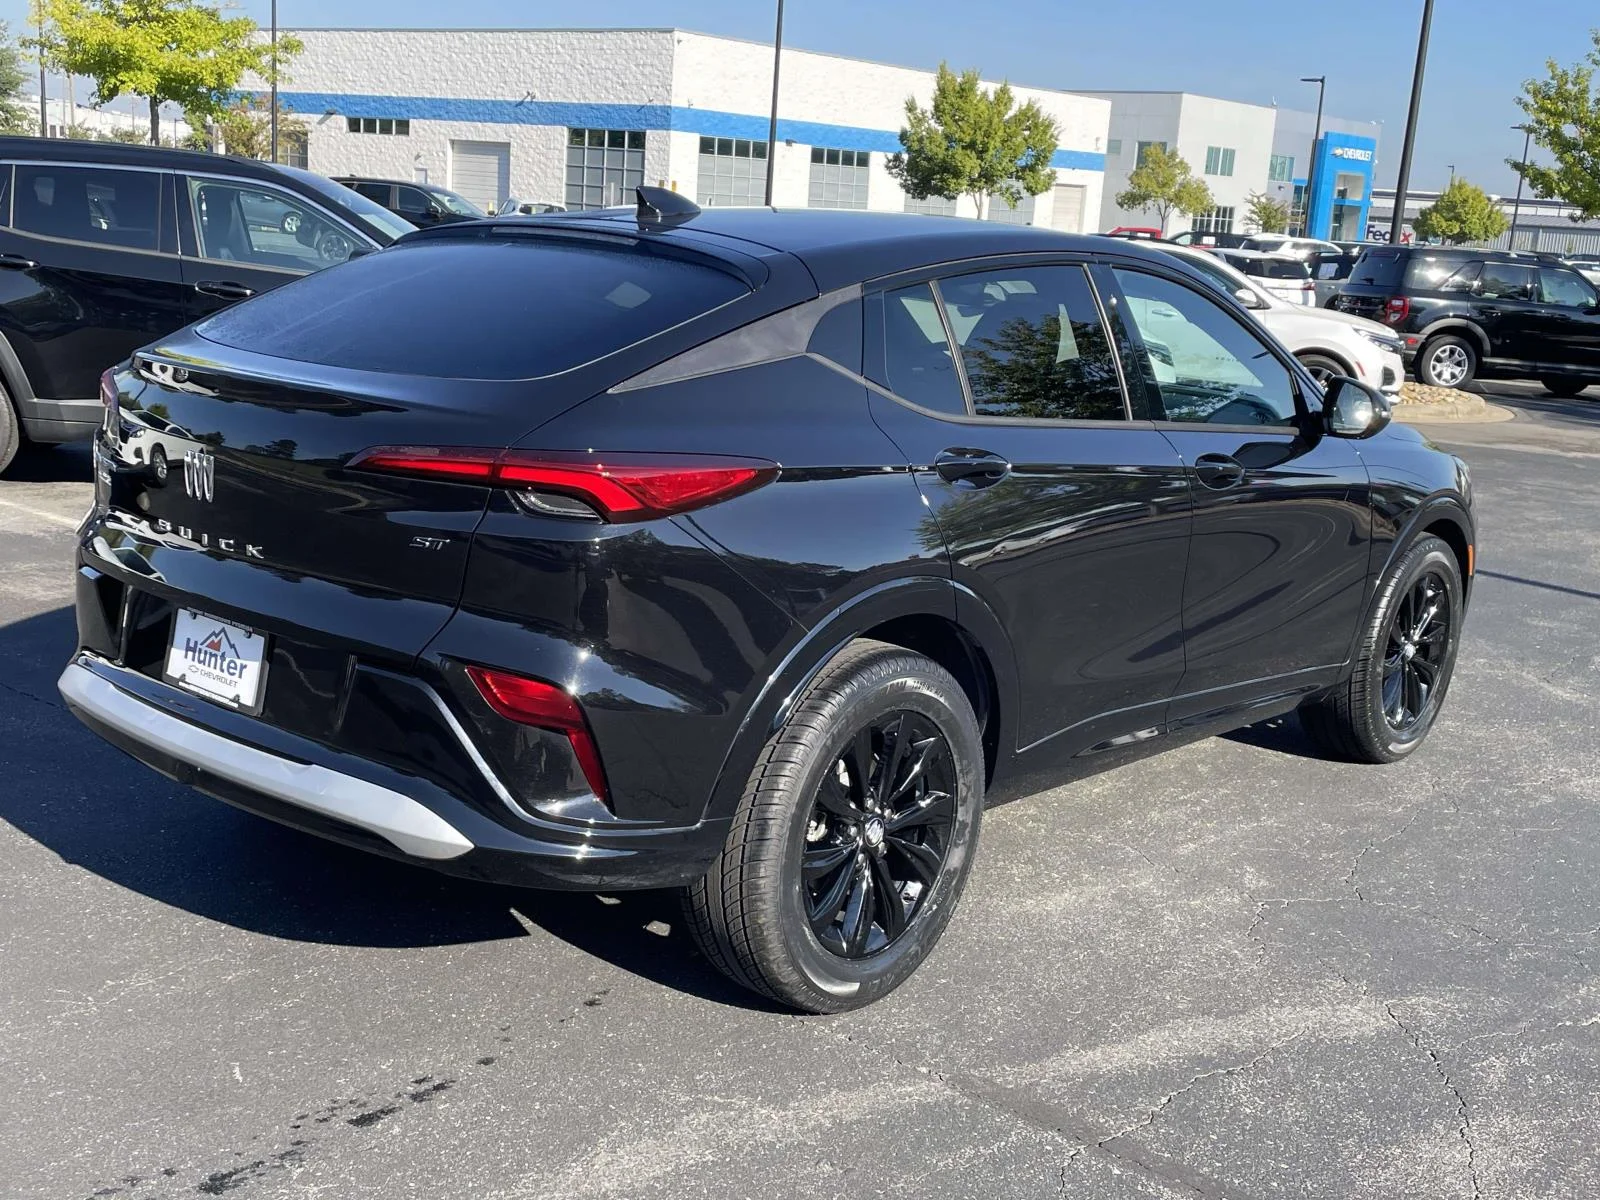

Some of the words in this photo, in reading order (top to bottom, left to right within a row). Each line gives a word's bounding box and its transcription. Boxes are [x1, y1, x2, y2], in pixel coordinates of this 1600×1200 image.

[1343, 147, 1373, 161] CHEVROLET
[1366, 224, 1413, 243] Fedx
[158, 518, 264, 559] BUICK
[409, 536, 451, 551] ST
[184, 637, 248, 680] Hunter
[200, 669, 238, 688] CHEVROLET
